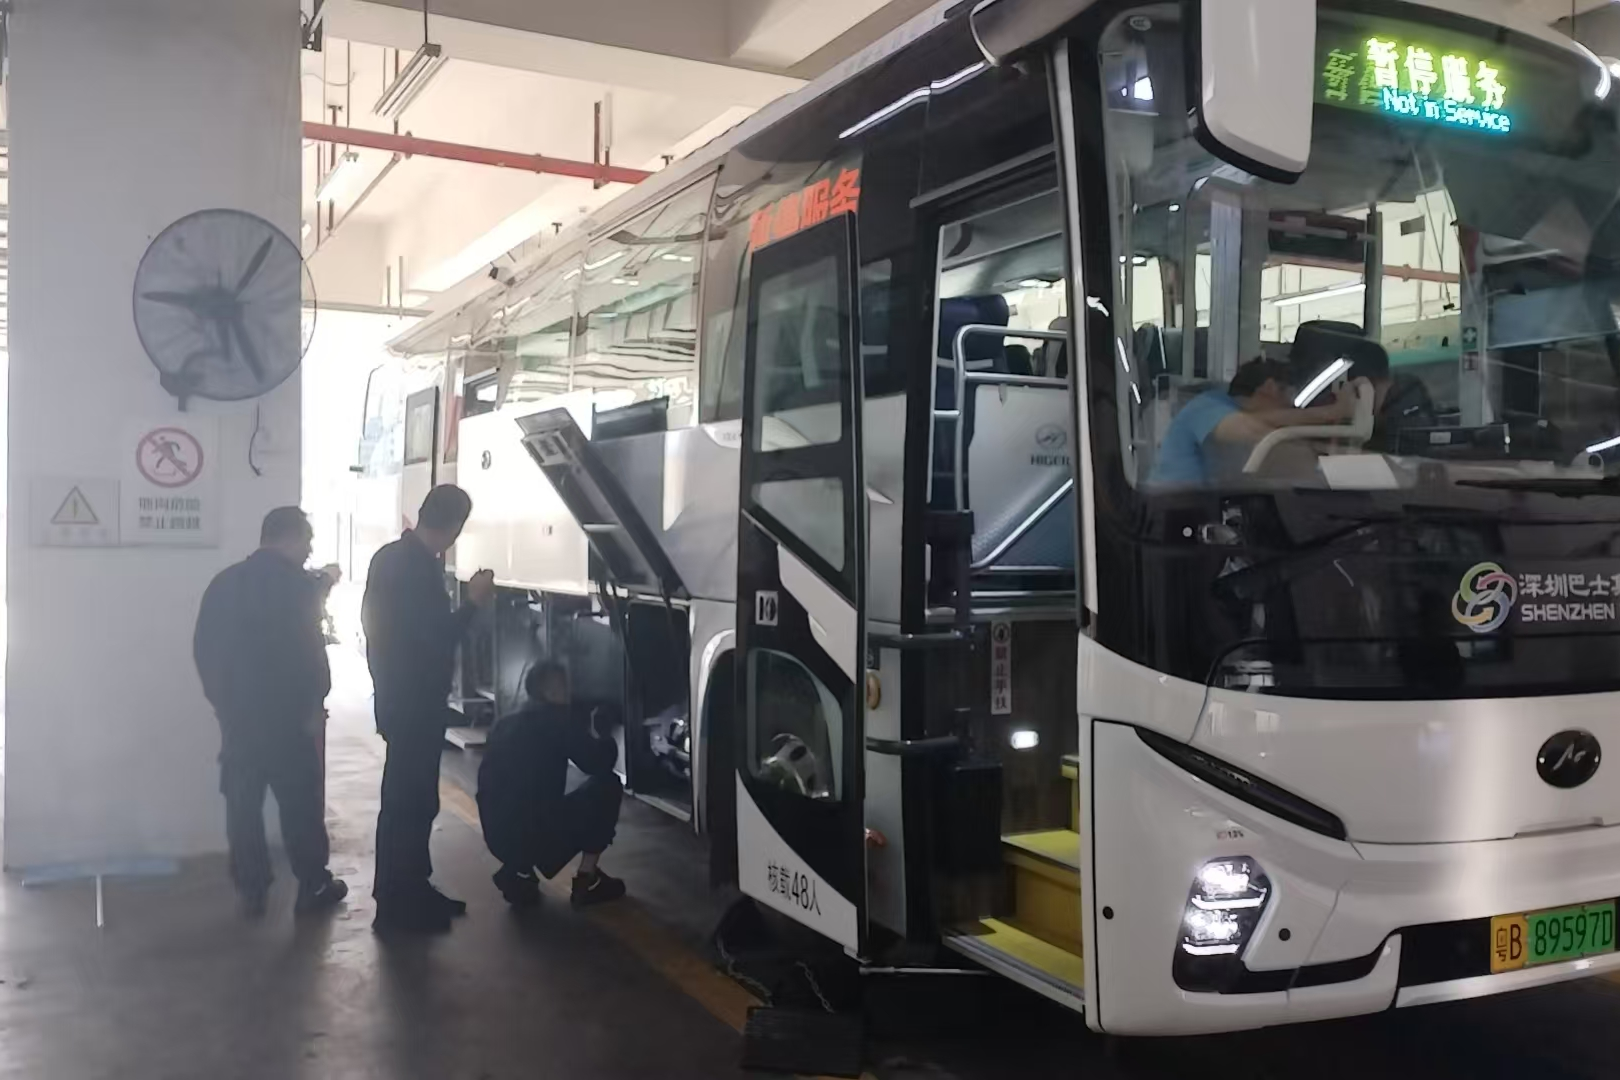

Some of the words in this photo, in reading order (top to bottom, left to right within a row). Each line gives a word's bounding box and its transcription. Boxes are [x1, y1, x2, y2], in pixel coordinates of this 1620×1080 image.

[1366, 37, 1507, 109] 暂停服务
[1382, 88, 1419, 114] Not
[1424, 95, 1440, 119] in
[1445, 100, 1511, 132] Service
[1521, 603, 1615, 622] SHENZHEN
[767, 861, 822, 916] 核载48人
[1535, 910, 1613, 956] 89597D
